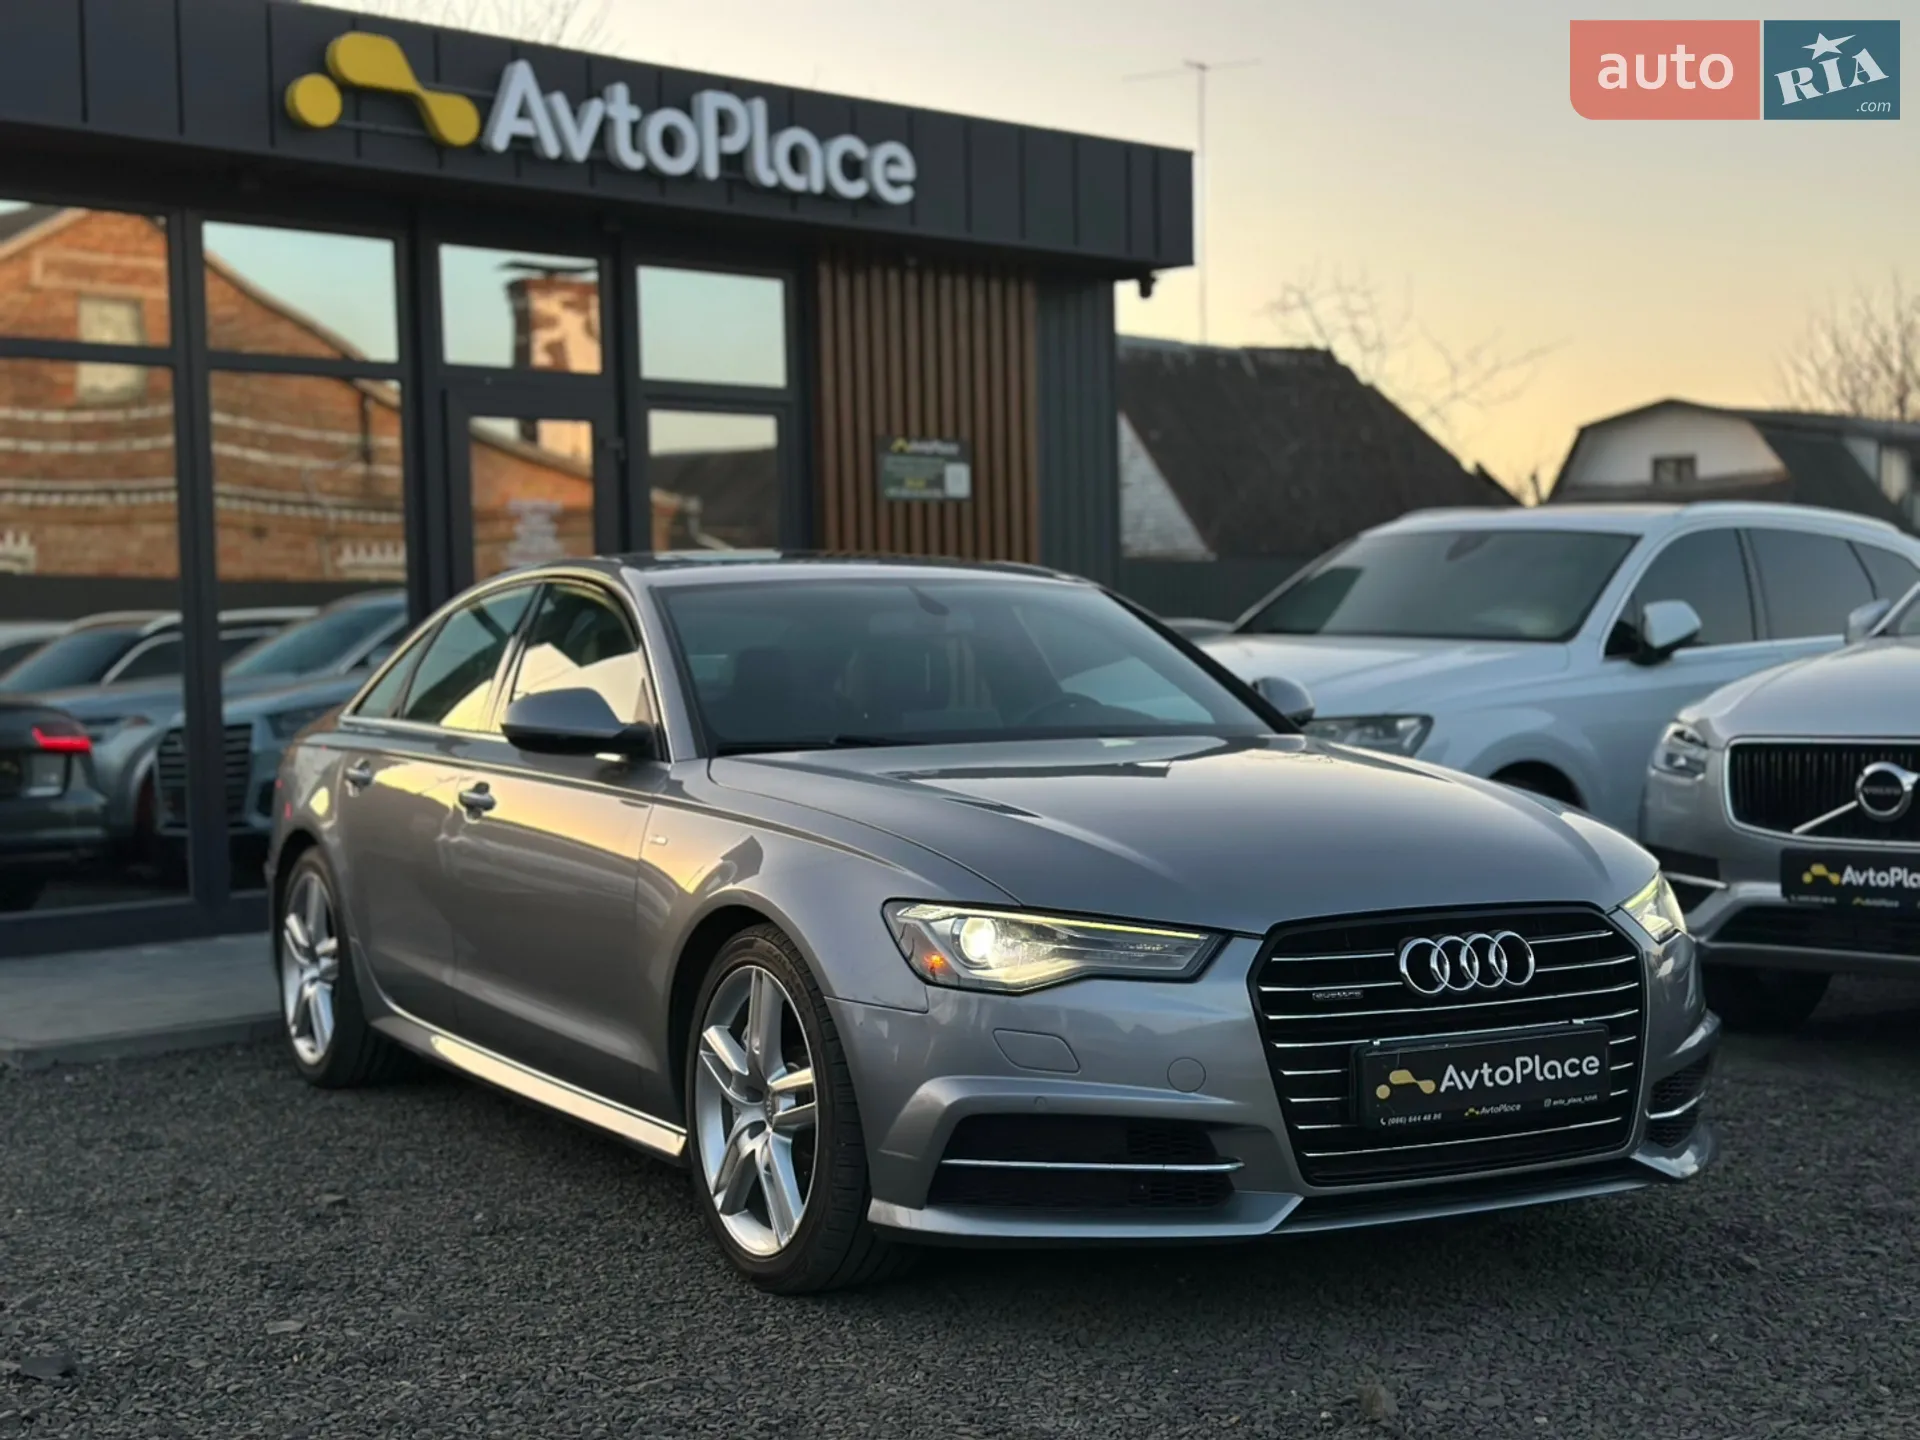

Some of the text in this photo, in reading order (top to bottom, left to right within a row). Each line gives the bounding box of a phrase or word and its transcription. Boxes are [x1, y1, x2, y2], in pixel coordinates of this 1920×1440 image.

[482, 59, 917, 205] AvtoPlace
[1439, 1054, 1600, 1093] AvtoPlace
[1480, 1103, 1521, 1115] AvtoPlace
